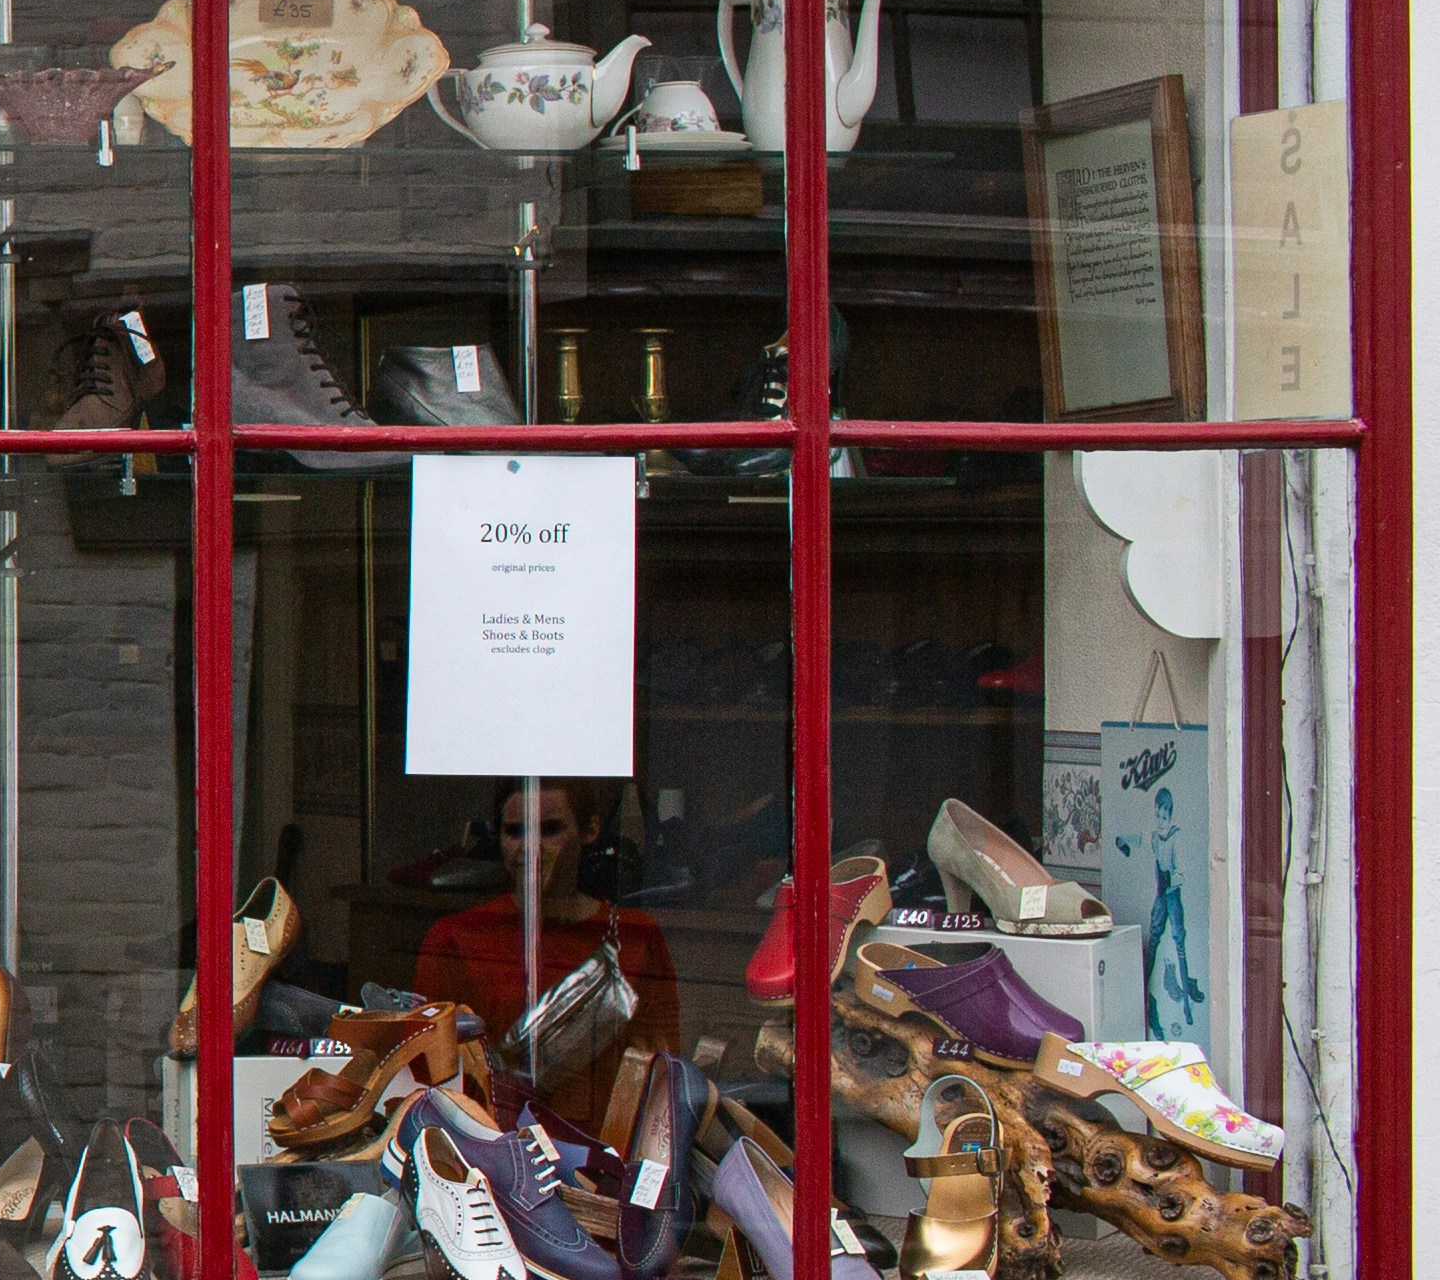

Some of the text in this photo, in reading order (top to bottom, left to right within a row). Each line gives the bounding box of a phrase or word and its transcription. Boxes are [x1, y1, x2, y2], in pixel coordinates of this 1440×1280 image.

[272, 0, 313, 18] £35
[480, 523, 570, 544] 20% off
[492, 563, 555, 574] original prices
[482, 613, 565, 625] Ladies & Mens
[482, 629, 565, 641] Shoes & Boots
[491, 644, 556, 656] excludes clogs
[897, 909, 928, 925] £40
[942, 914, 981, 929] £125
[937, 1040, 969, 1057] £44
